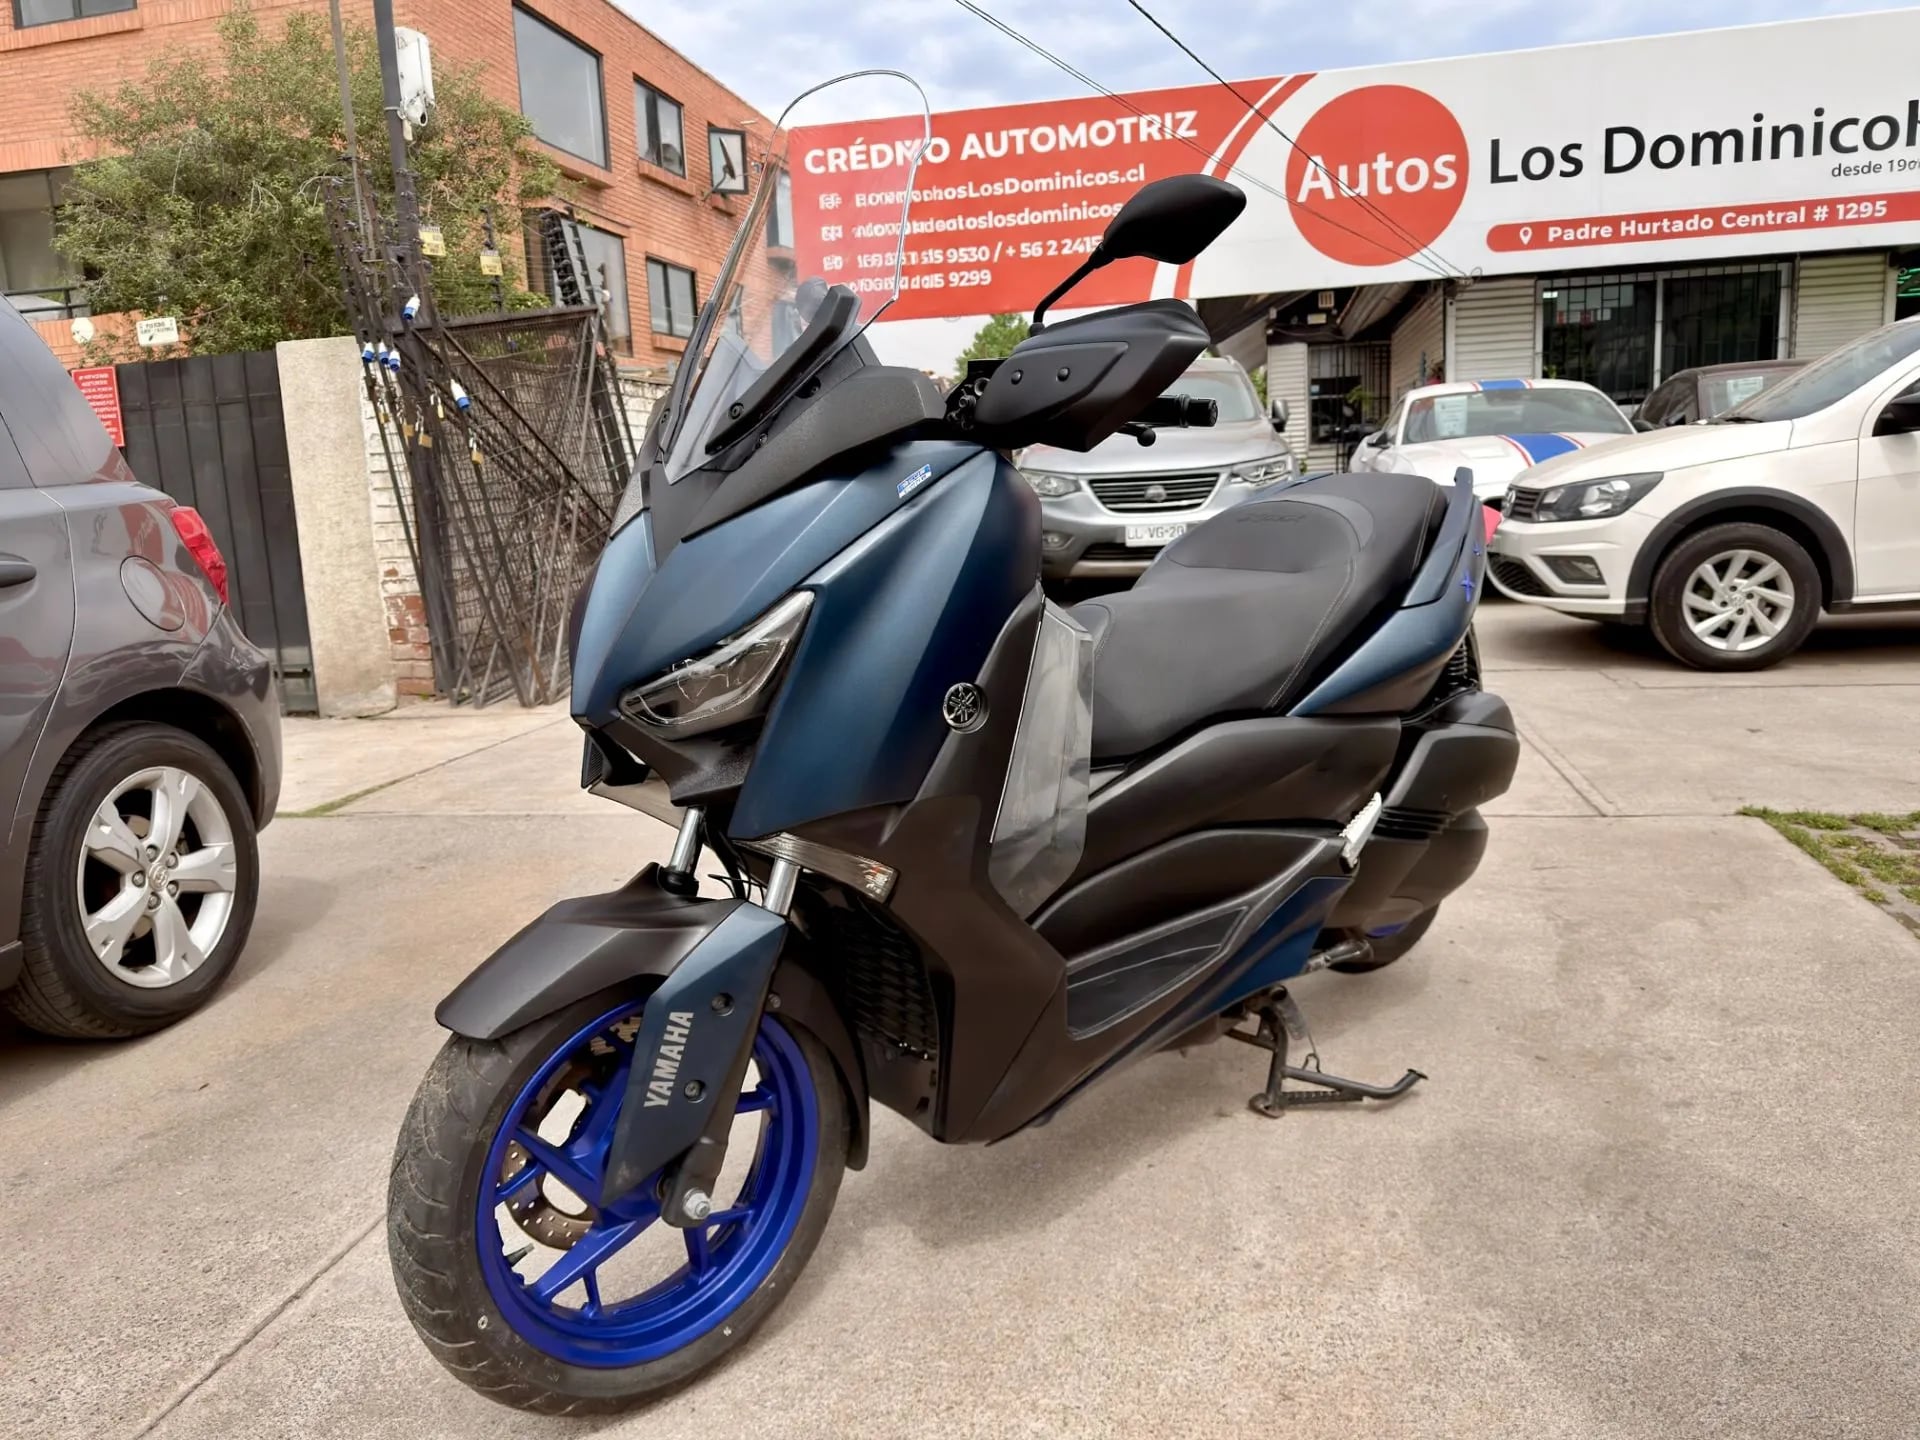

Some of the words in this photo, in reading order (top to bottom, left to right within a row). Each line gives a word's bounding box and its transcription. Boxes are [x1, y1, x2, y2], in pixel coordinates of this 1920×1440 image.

[960, 110, 1198, 161] AUTOMOTRIZ
[1297, 152, 1457, 203] Autos
[1490, 138, 1583, 183] Los
[1831, 160, 1883, 178] desde
[1548, 223, 1613, 242] Padre
[1620, 214, 1714, 237] Hurtado
[1721, 206, 1806, 229] Central
[1813, 205, 1829, 222] #
[1836, 200, 1887, 220] 1295
[947, 245, 990, 264] 9530
[1020, 240, 1043, 258] 56
[1047, 240, 1058, 256] 2
[949, 269, 992, 287] 9299
[643, 1011, 694, 1107] YAMAHA
